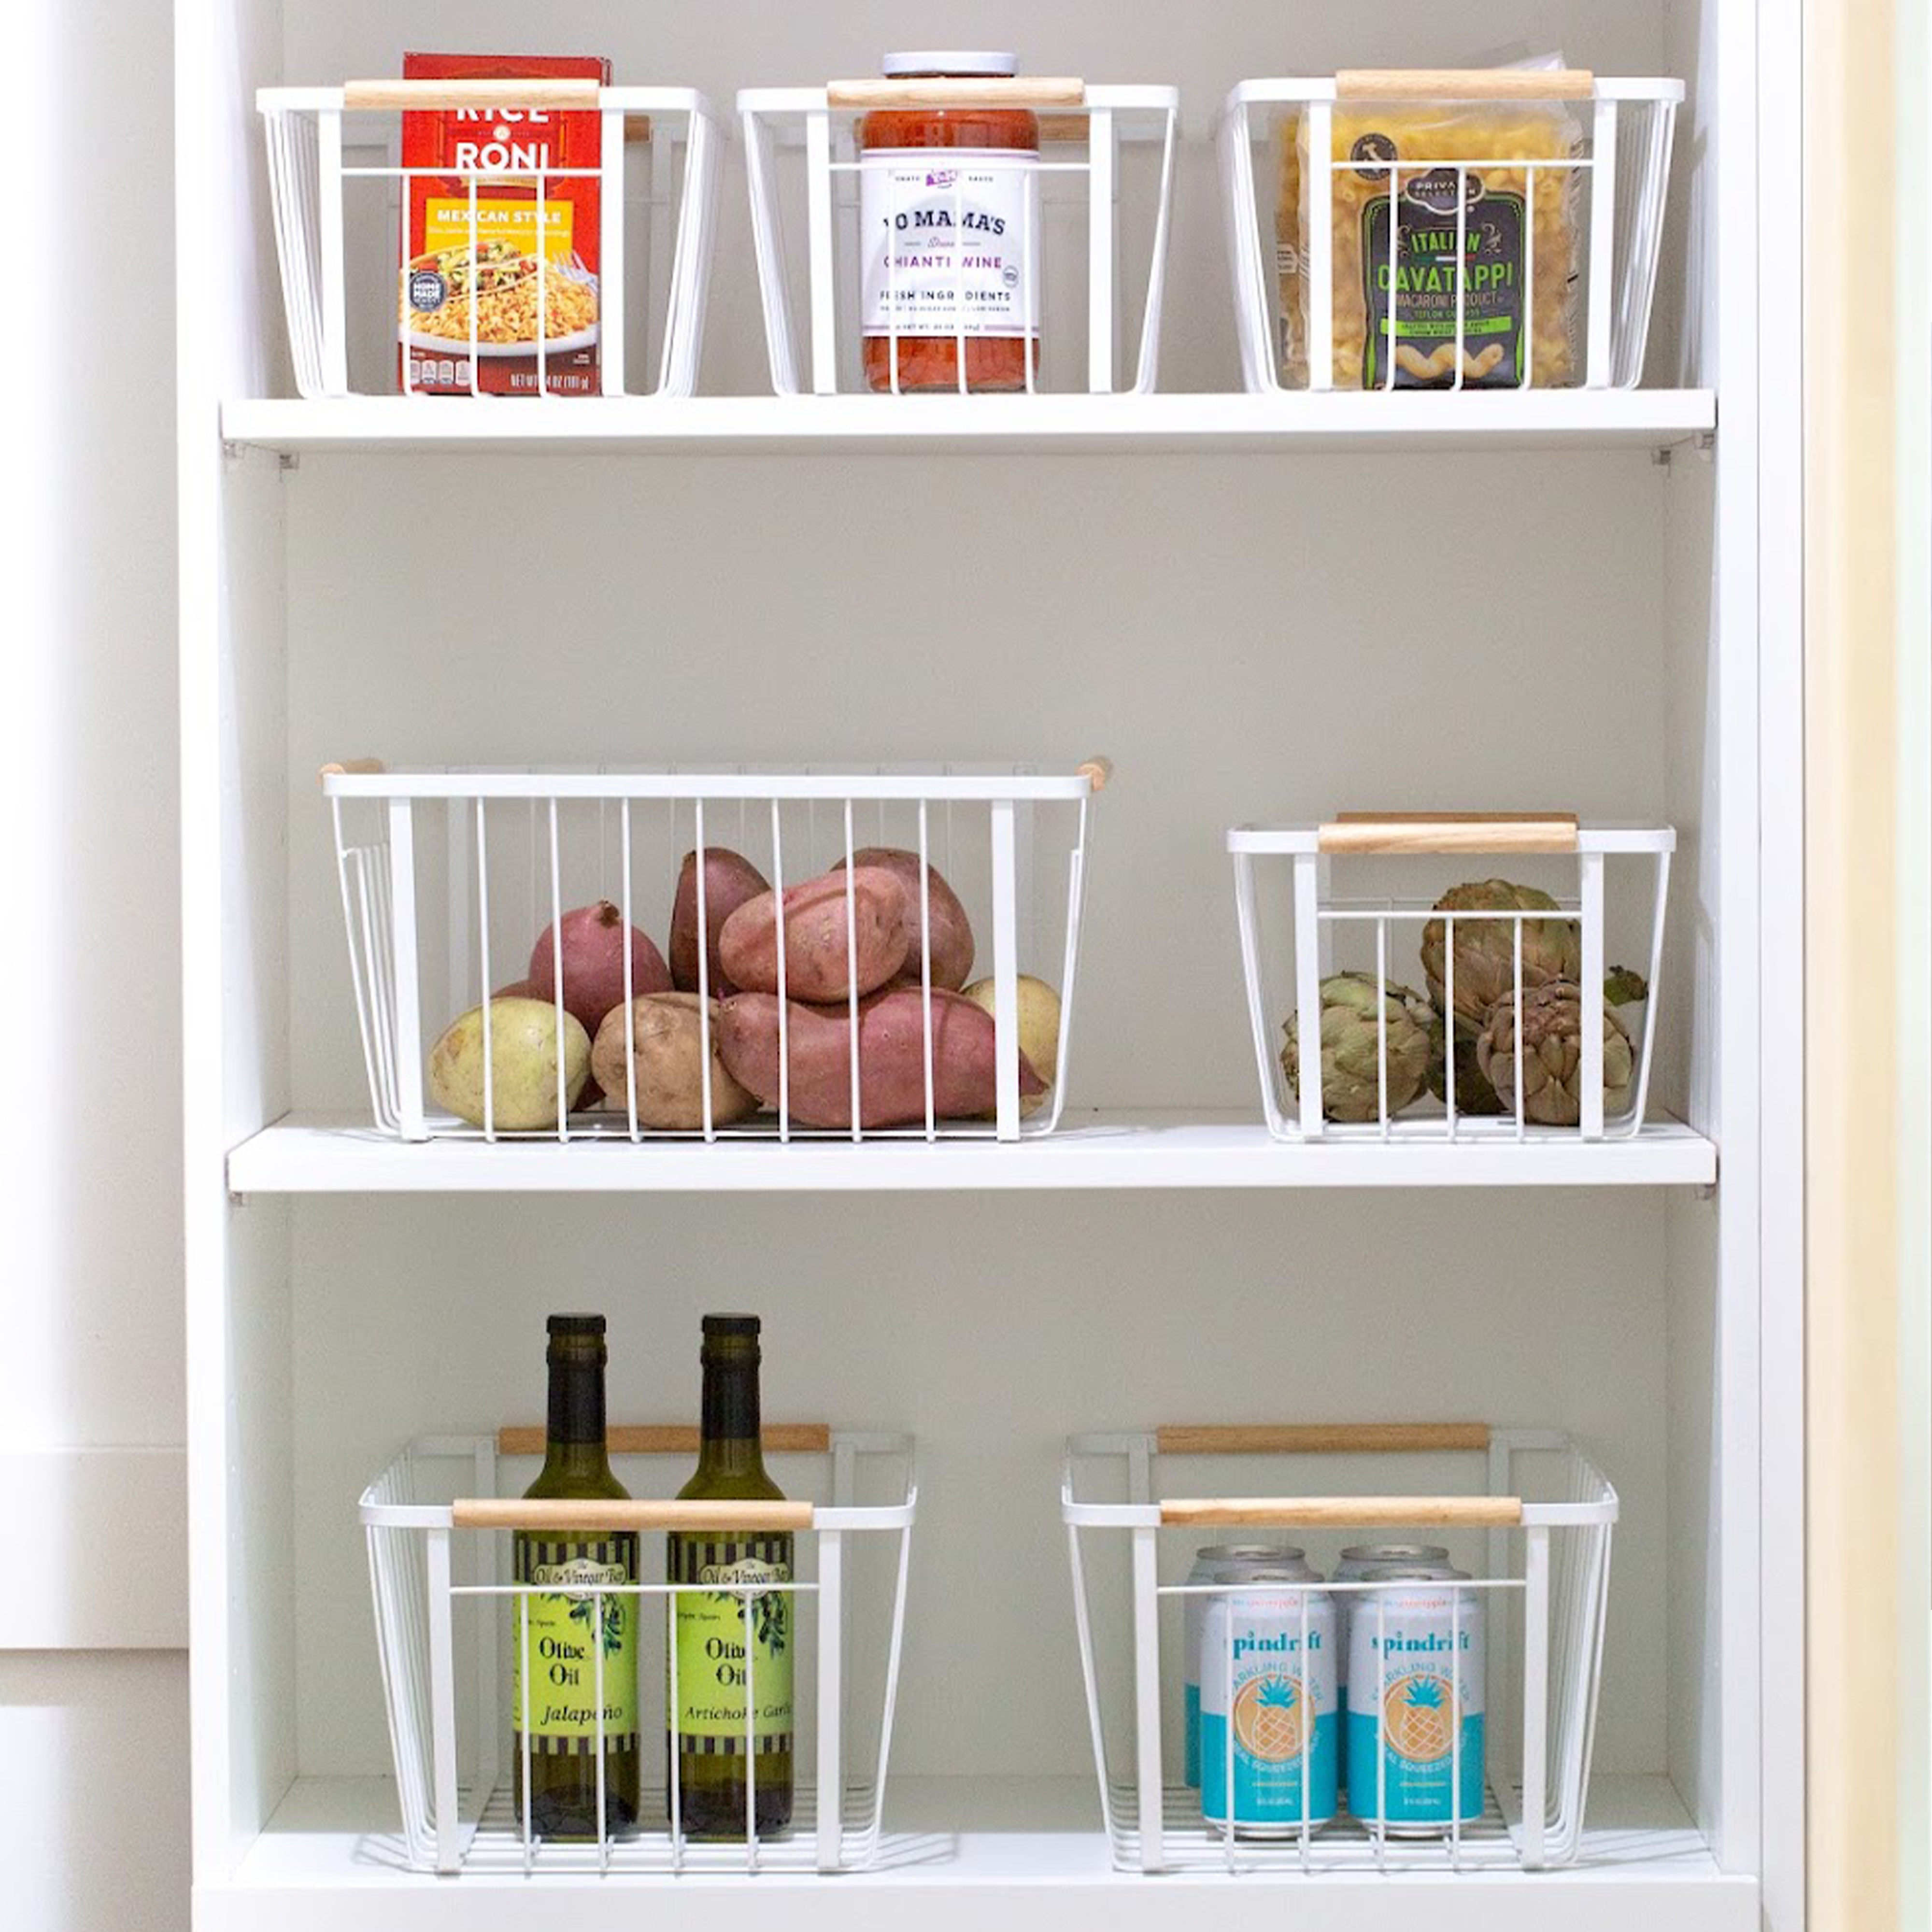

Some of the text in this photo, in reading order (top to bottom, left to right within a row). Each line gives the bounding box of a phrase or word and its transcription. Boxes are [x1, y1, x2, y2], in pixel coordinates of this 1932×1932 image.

[456, 142, 549, 170] RONI
[1416, 177, 1460, 190] PRIVA
[437, 209, 509, 222] MEXCAN
[914, 210, 1006, 236] MAMA'S
[1411, 232, 1481, 253] ITALIN
[921, 291, 1011, 301] INGRDIENTS
[1450, 291, 1497, 308] PODUCT
[540, 1636, 585, 1659] Olive
[706, 1637, 746, 1660] Oliv
[1233, 1630, 1321, 1660] pindrft
[550, 1663, 579, 1686] Oil
[716, 1663, 747, 1686] Oil
